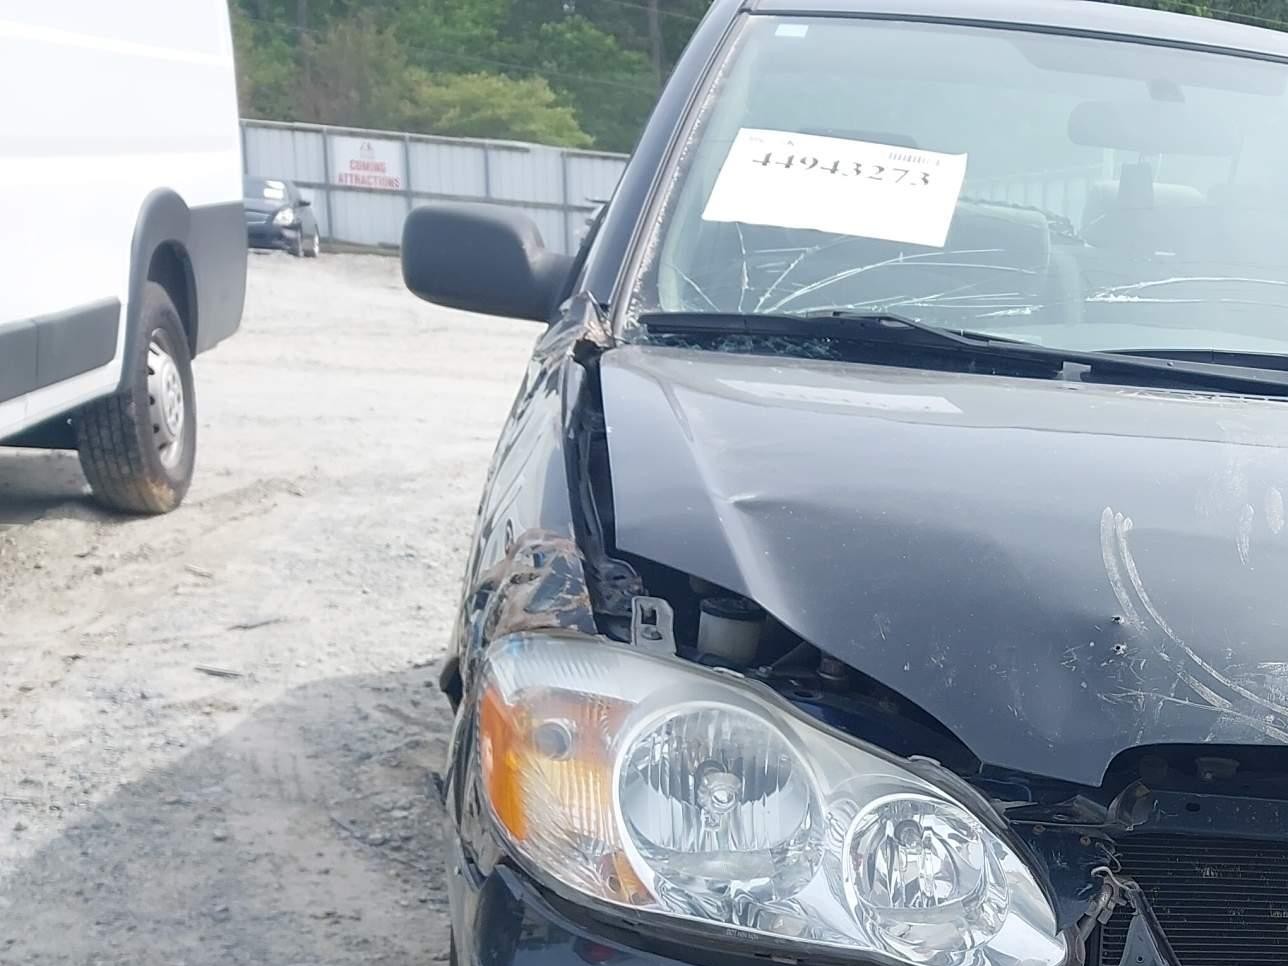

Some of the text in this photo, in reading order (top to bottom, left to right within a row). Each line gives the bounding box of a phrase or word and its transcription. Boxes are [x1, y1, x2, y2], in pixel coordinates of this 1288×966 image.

[350, 159, 386, 172] COMING
[752, 152, 931, 186] 44943273
[338, 173, 400, 189] ATTRACTIONS
